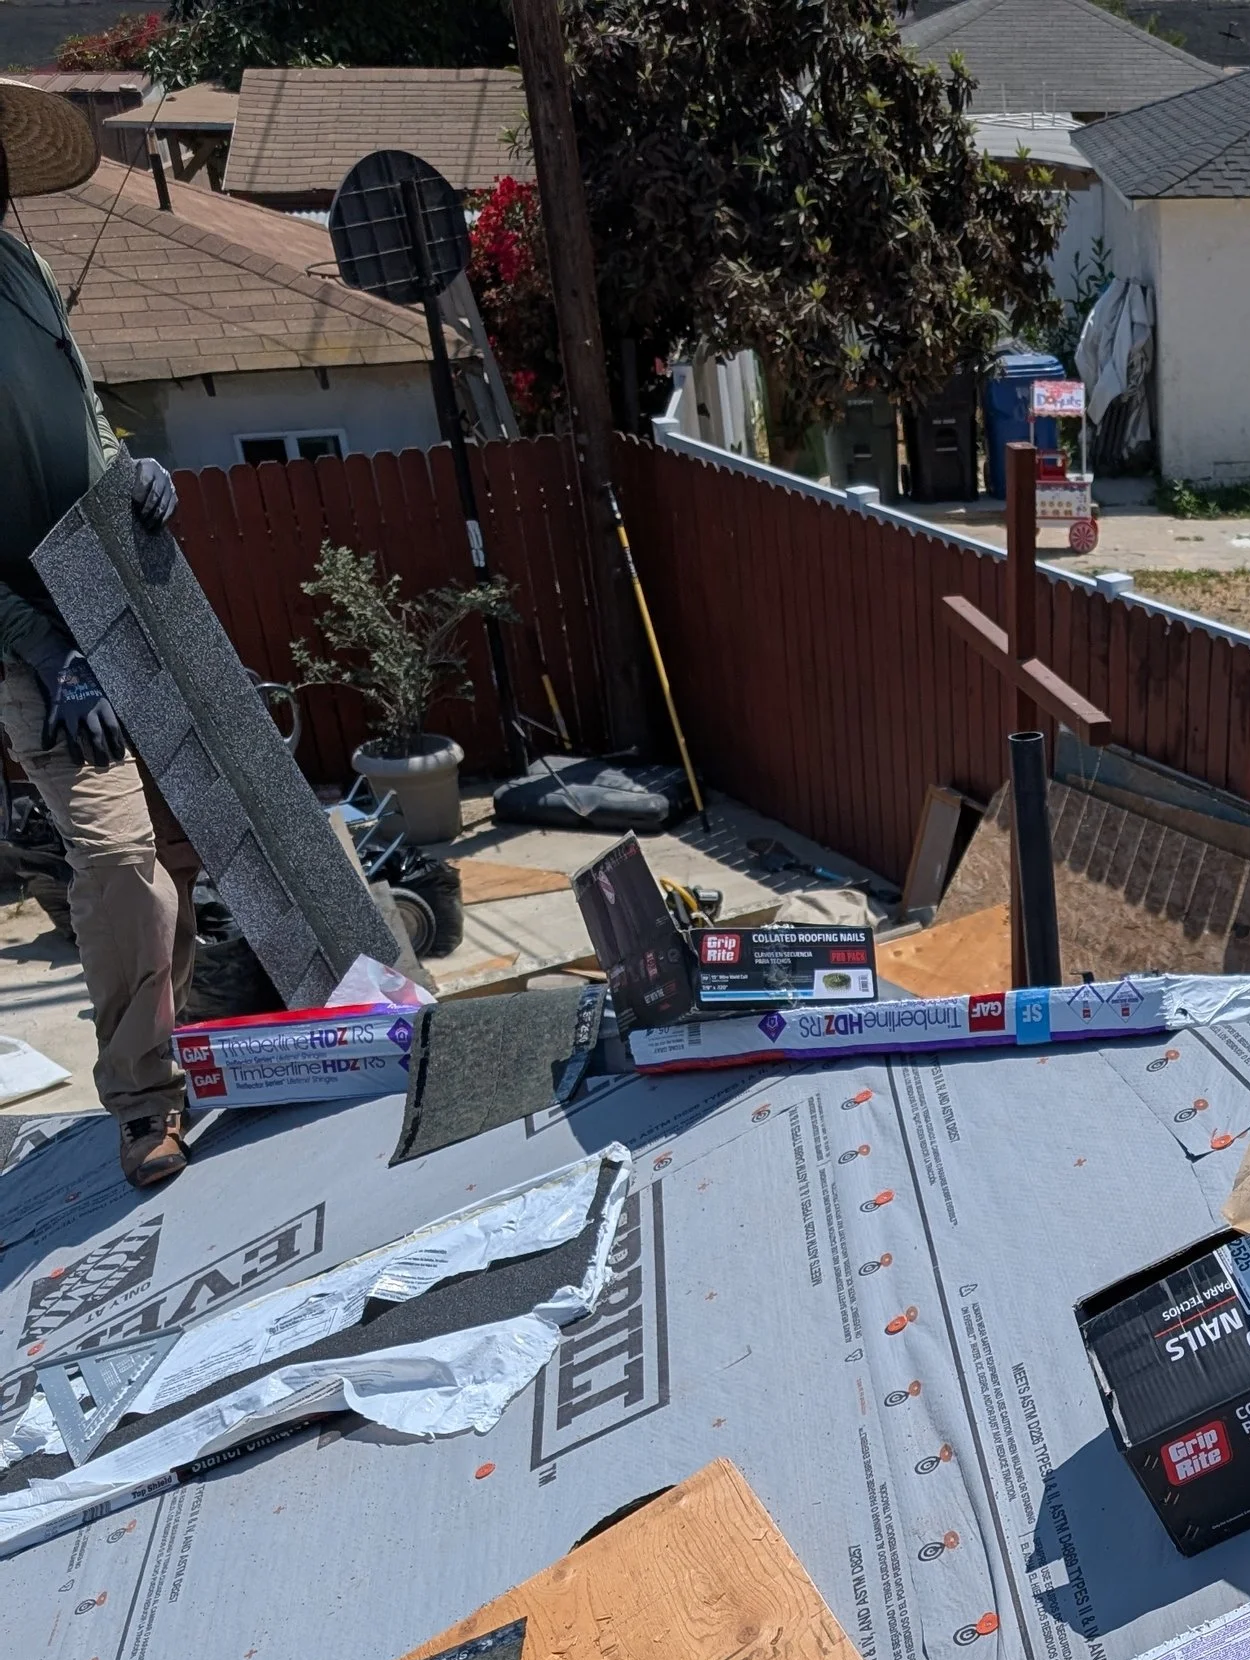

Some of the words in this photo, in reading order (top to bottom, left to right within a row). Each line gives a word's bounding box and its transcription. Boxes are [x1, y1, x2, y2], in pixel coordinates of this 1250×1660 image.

[707, 936, 736, 950] Grip
[752, 933, 797, 943] COLLATED
[798, 934, 838, 942] ROOFING
[839, 933, 865, 942] NAILS
[707, 949, 735, 961] Rite
[971, 999, 1001, 1019] GAF
[1022, 1003, 1042, 1022] SF
[182, 1047, 210, 1062] GAF
[193, 1073, 221, 1086] GAF
[1202, 1281, 1233, 1302] PARA
[1162, 1294, 1202, 1321] TECHOS
[1165, 1308, 1243, 1362] NAILS
[1010, 1361, 1030, 1394] MEETS
[1168, 1428, 1218, 1463] Grip
[1030, 1443, 1056, 1478] TYPES
[1175, 1448, 1222, 1481] Rite
[131, 1489, 147, 1500] Top
[147, 1475, 173, 1493] Shield
[1048, 1502, 1069, 1534] ASTM
[1056, 1533, 1079, 1568] D4869
[1064, 1565, 1091, 1605] TYPES
